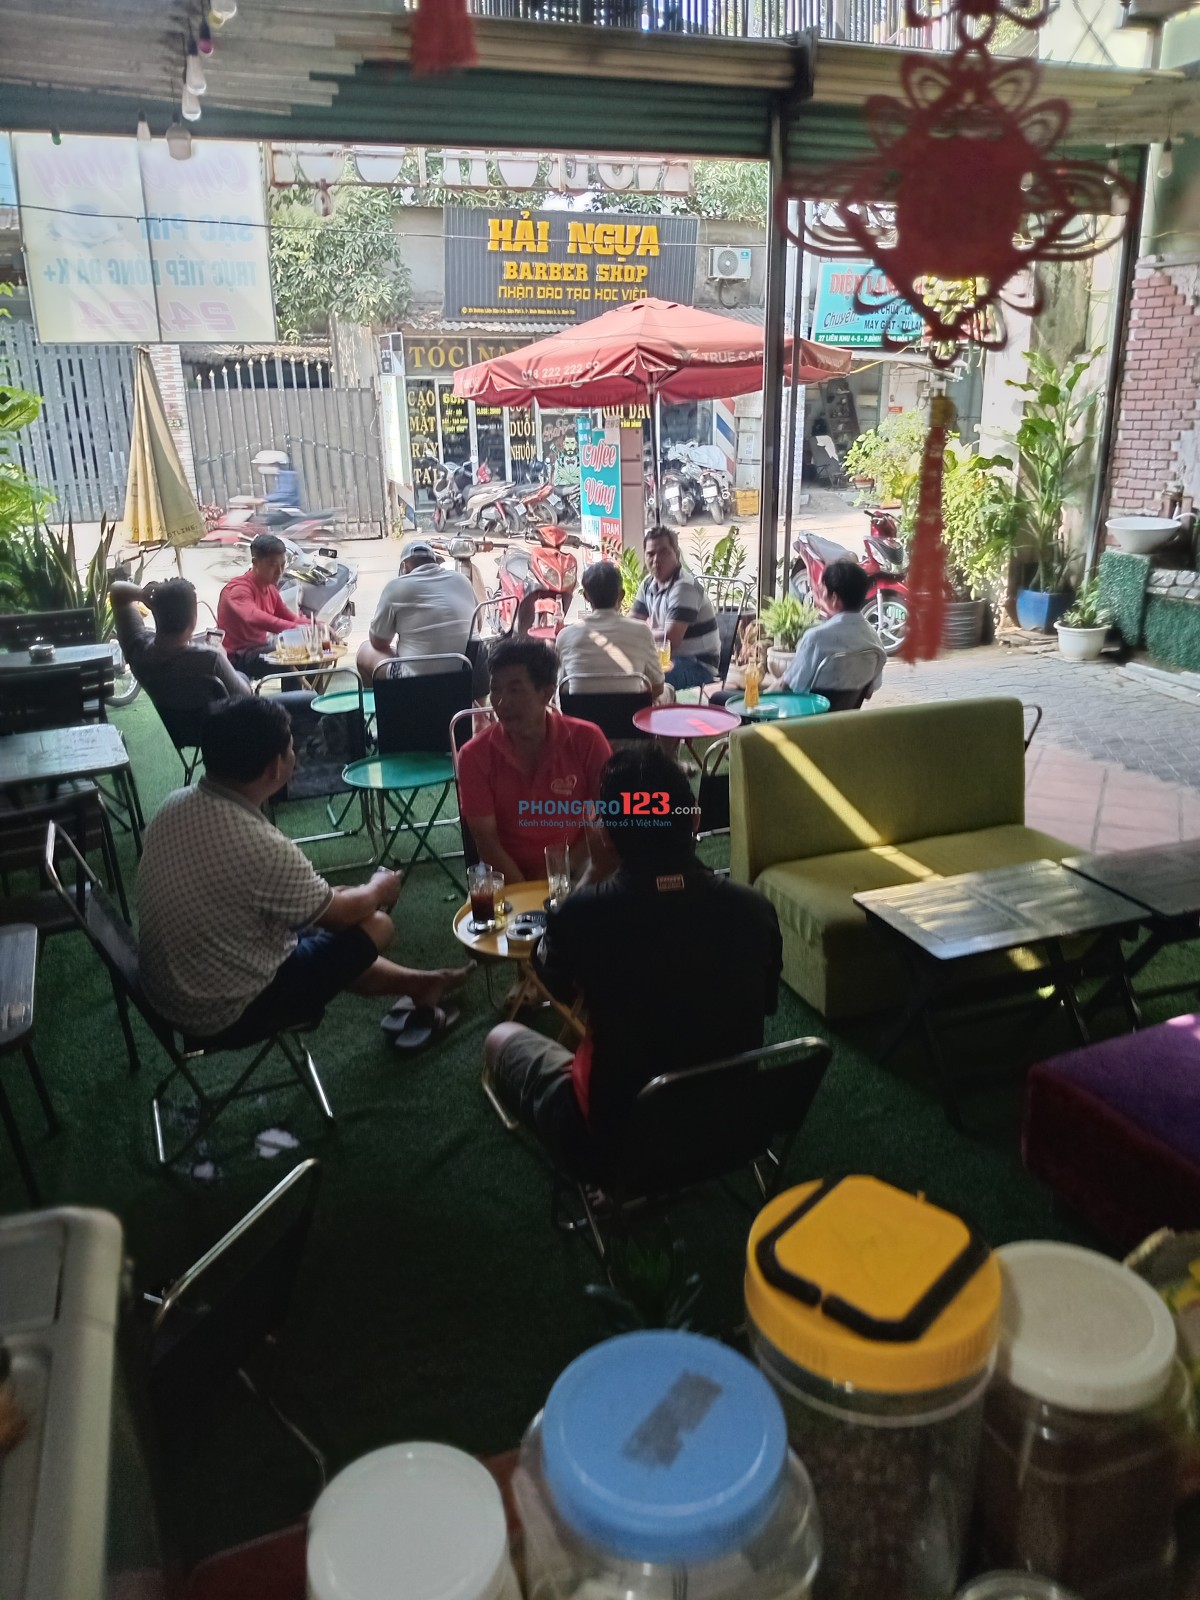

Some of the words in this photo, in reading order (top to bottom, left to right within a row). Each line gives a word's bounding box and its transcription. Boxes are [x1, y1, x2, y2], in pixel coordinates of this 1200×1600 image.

[488, 211, 550, 253] HẢI
[567, 221, 660, 262] NGỰA
[503, 261, 588, 281] BARBER
[596, 263, 648, 282] SHOP
[537, 282, 563, 299] ĐÀO
[566, 286, 591, 302] TẠO
[594, 287, 619, 302] HỌC
[409, 338, 464, 368] TÓC
[702, 352, 737, 363] TRUE
[738, 350, 764, 362] CAF
[582, 438, 617, 472] Coffee
